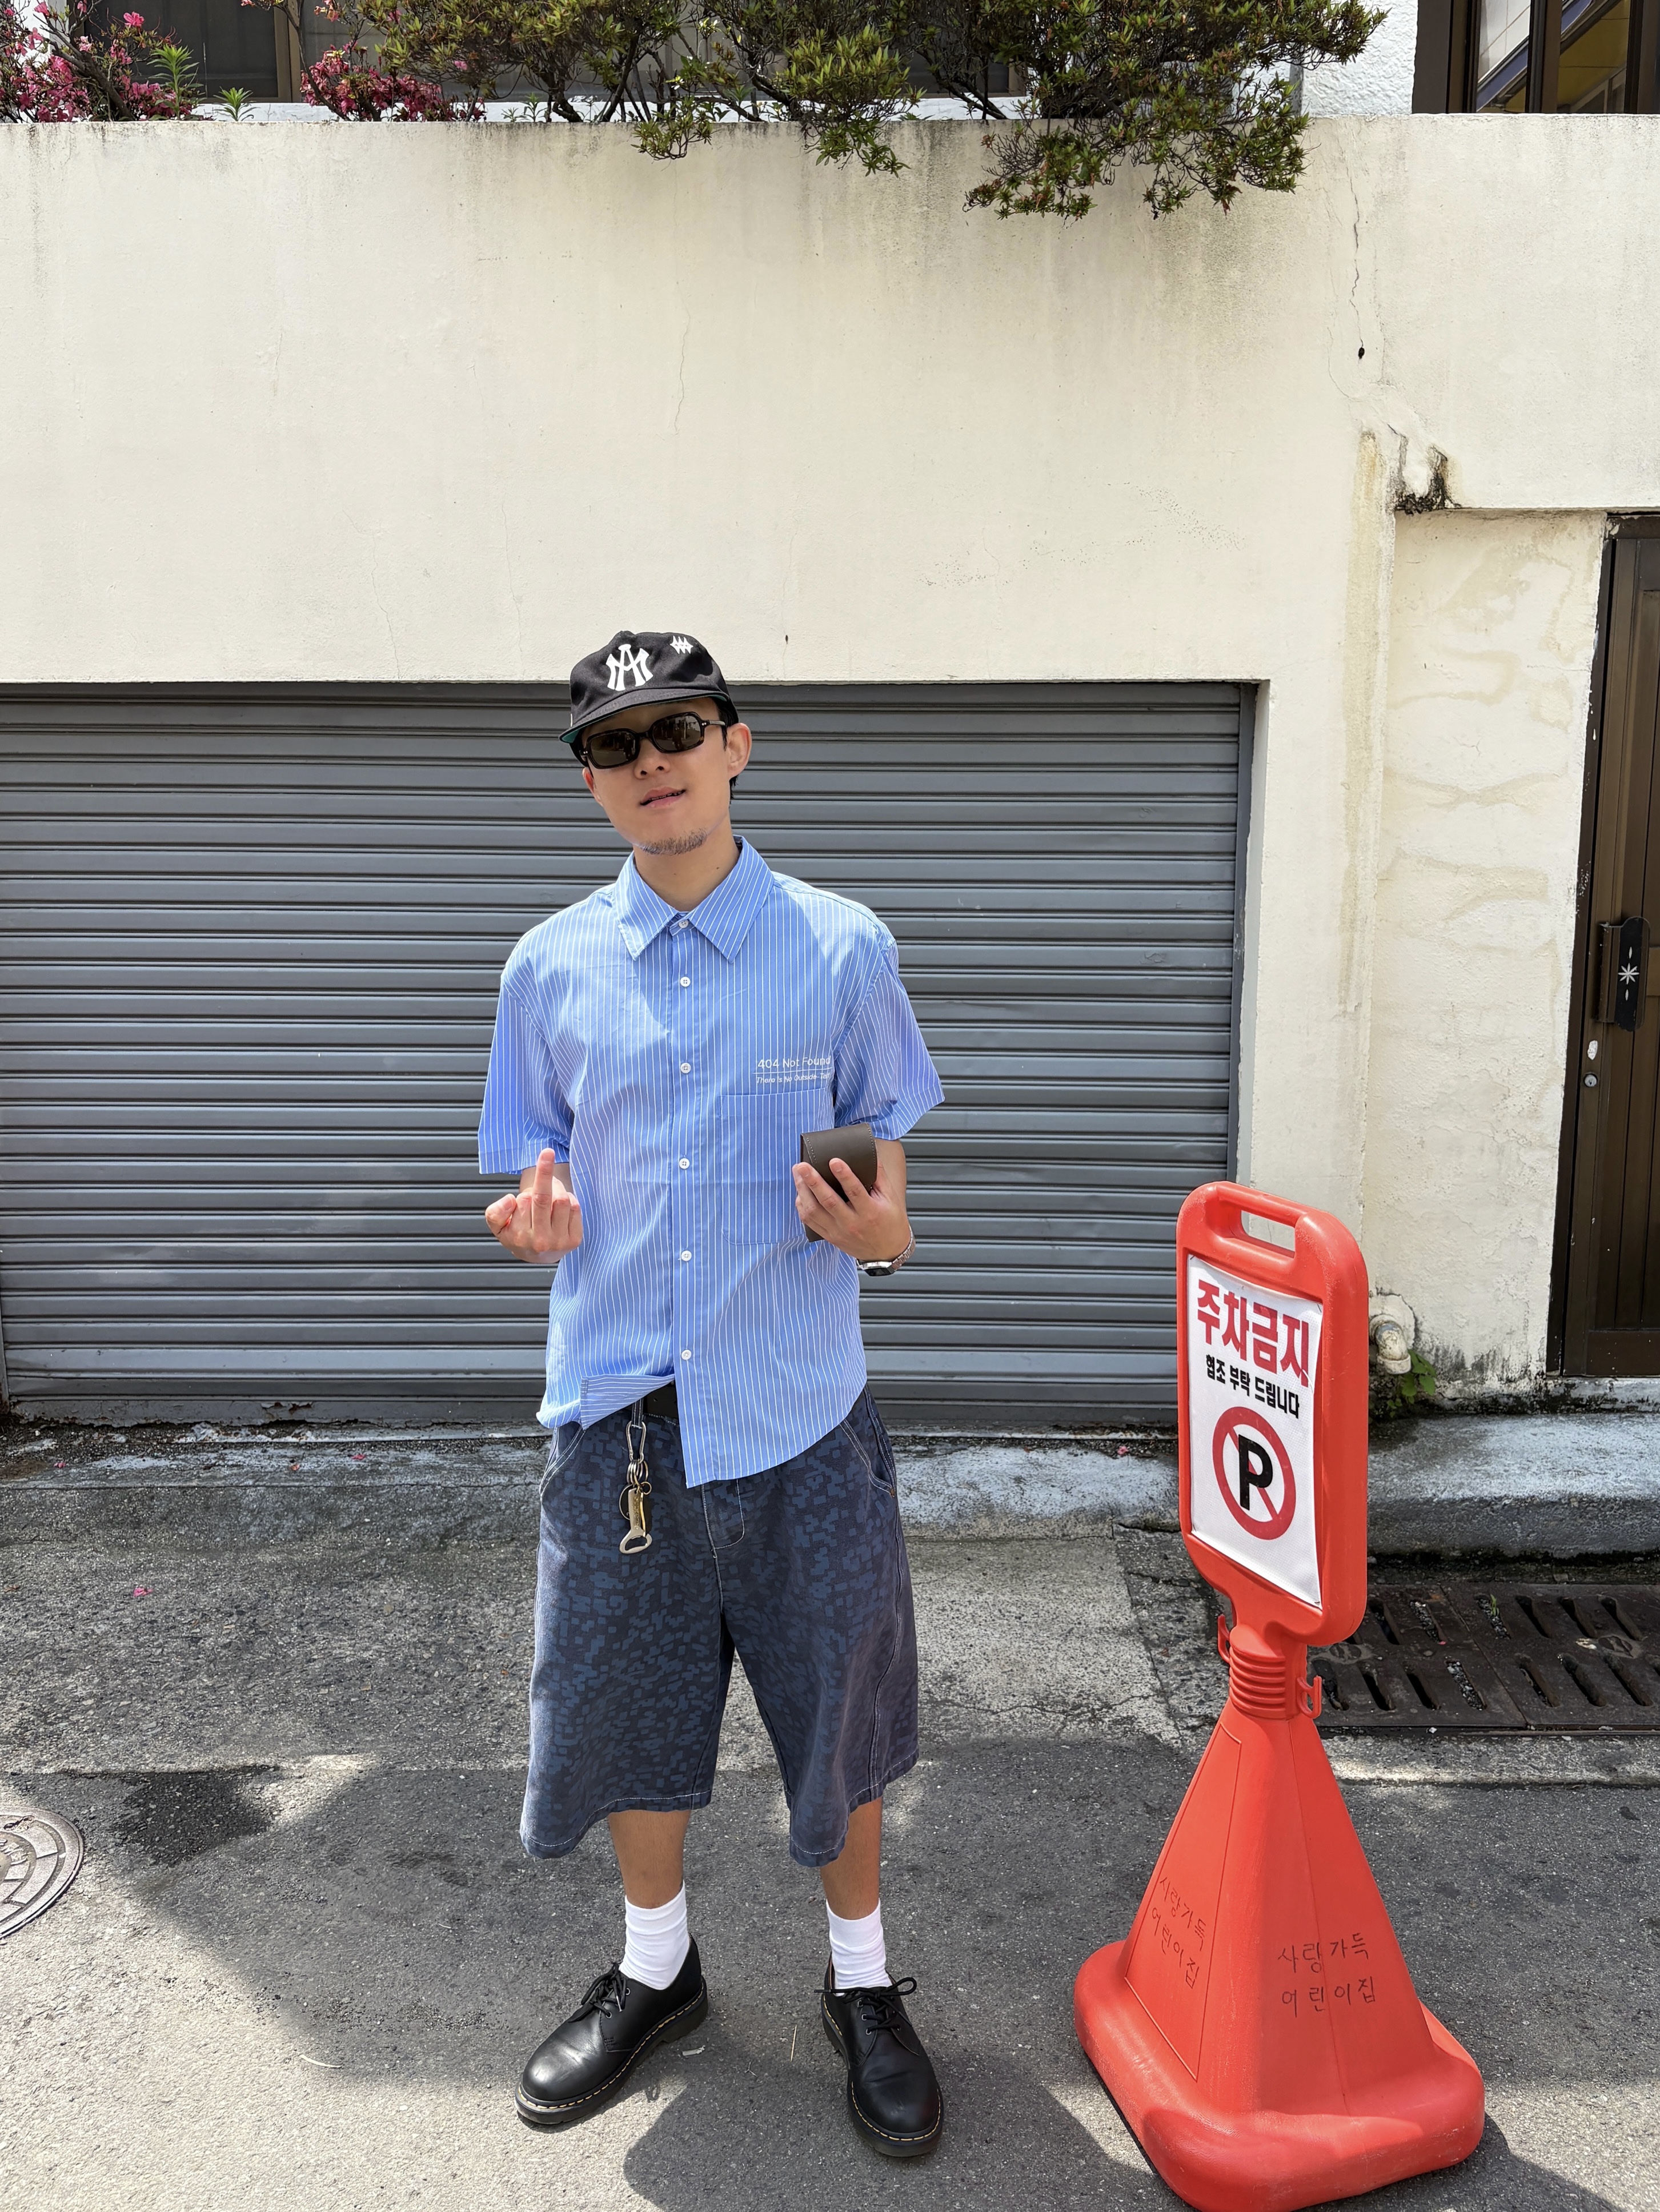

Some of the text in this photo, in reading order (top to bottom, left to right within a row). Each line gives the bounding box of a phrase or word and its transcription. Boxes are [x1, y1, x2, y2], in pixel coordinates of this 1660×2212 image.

[757, 1055, 831, 1069] 404 Not Found
[1197, 1279, 1309, 1388] 주차금지
[1206, 1354, 1300, 1419] 협조 부탁 드립니다
[1238, 1434, 1273, 1511] P
[1152, 1908, 1200, 1989] 어린이집
[1282, 1976, 1376, 2018] 어린이집
